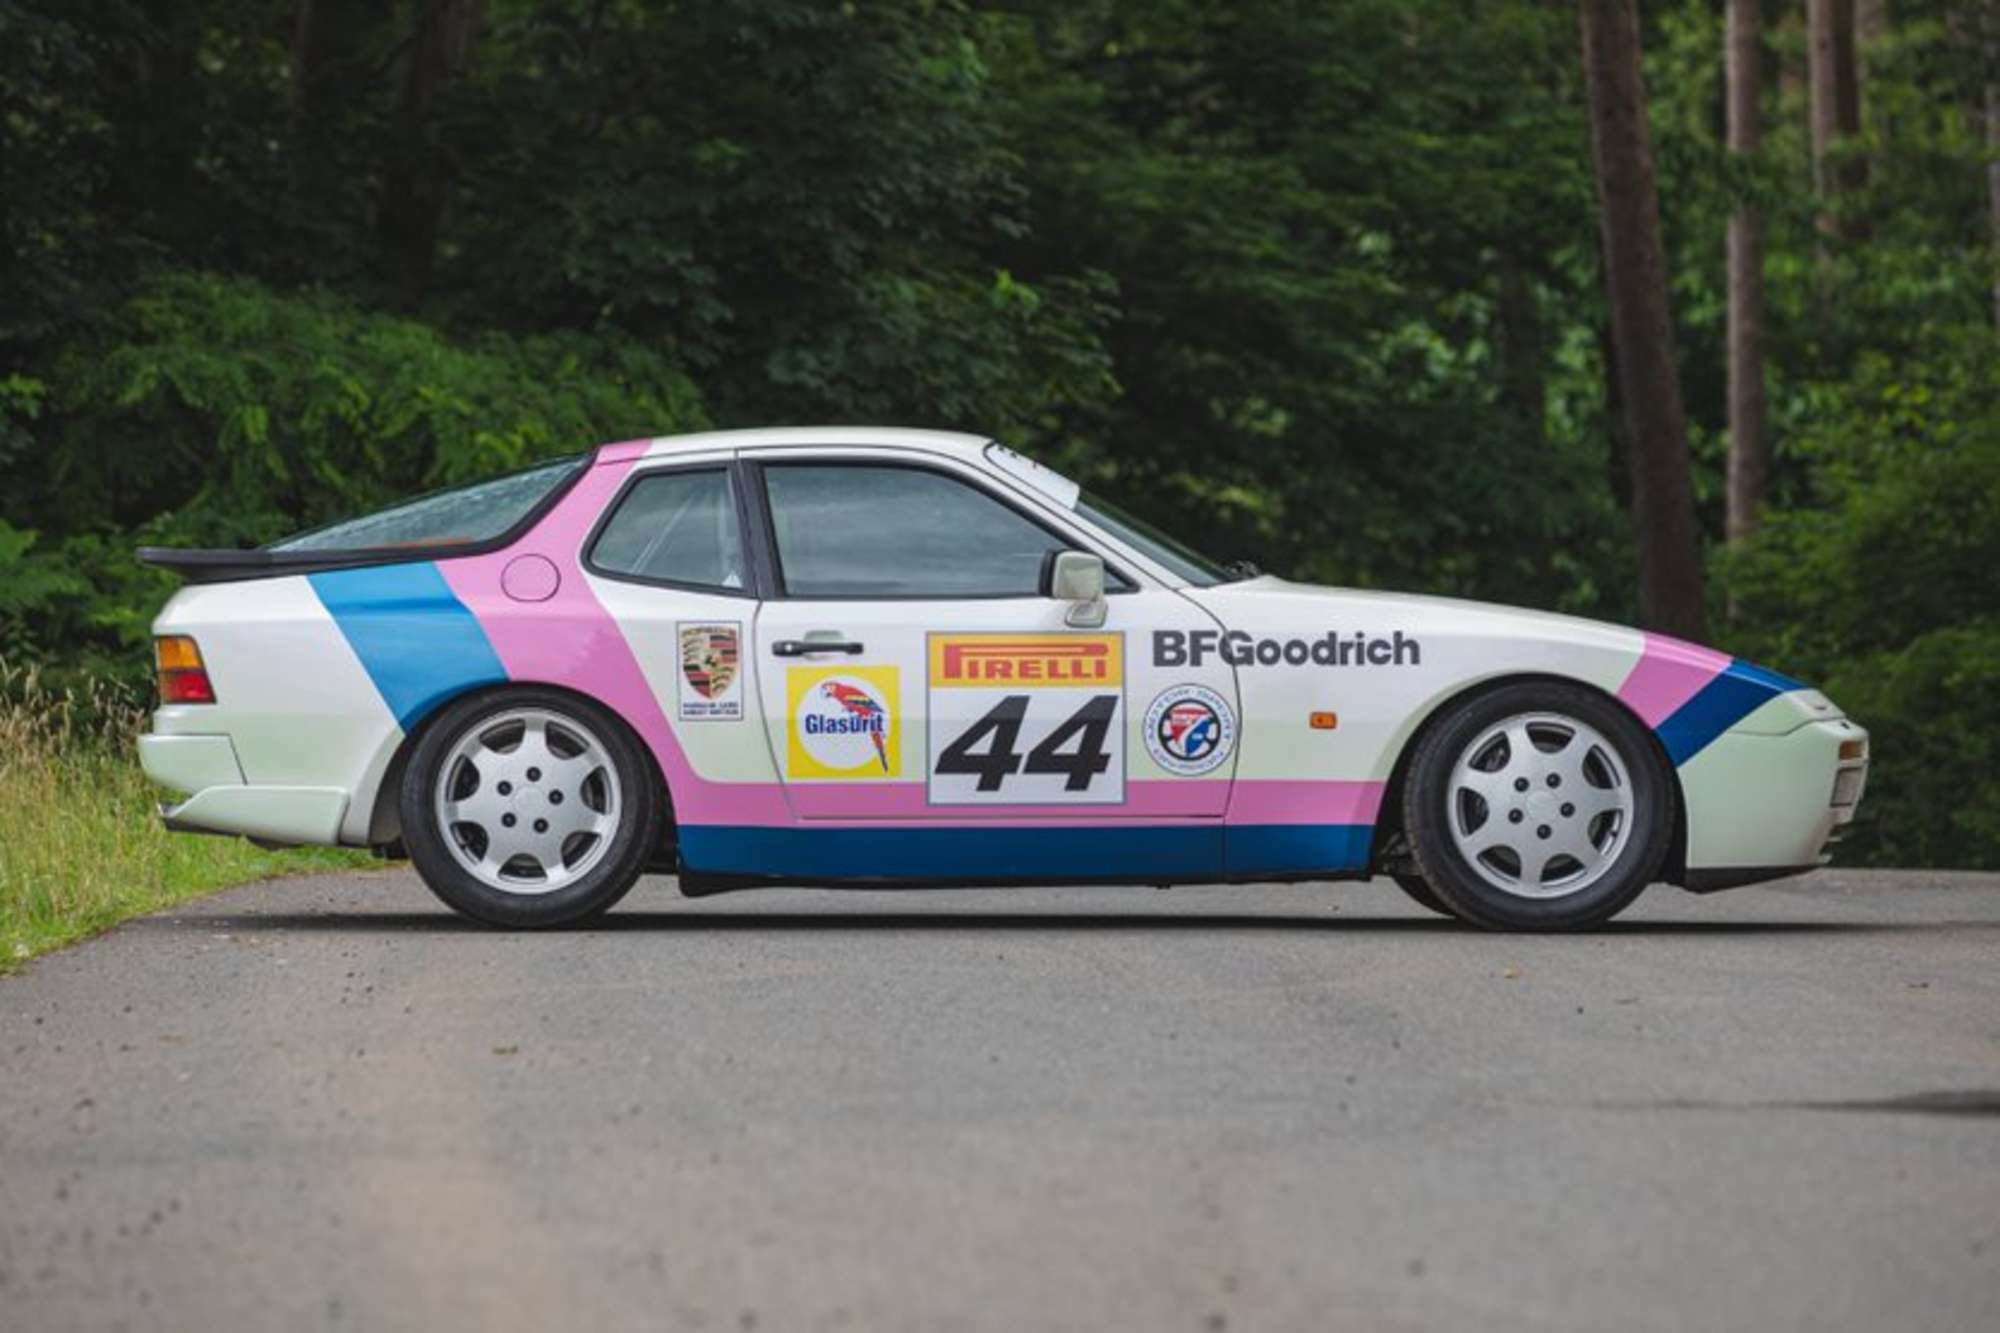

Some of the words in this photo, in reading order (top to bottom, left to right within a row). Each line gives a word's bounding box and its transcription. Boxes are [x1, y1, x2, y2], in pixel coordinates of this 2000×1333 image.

[944, 643, 1109, 679] PIRELLI
[1153, 630, 1420, 667] BFGoodrich
[805, 714, 884, 735] Glasurit
[935, 695, 1118, 792] 44
